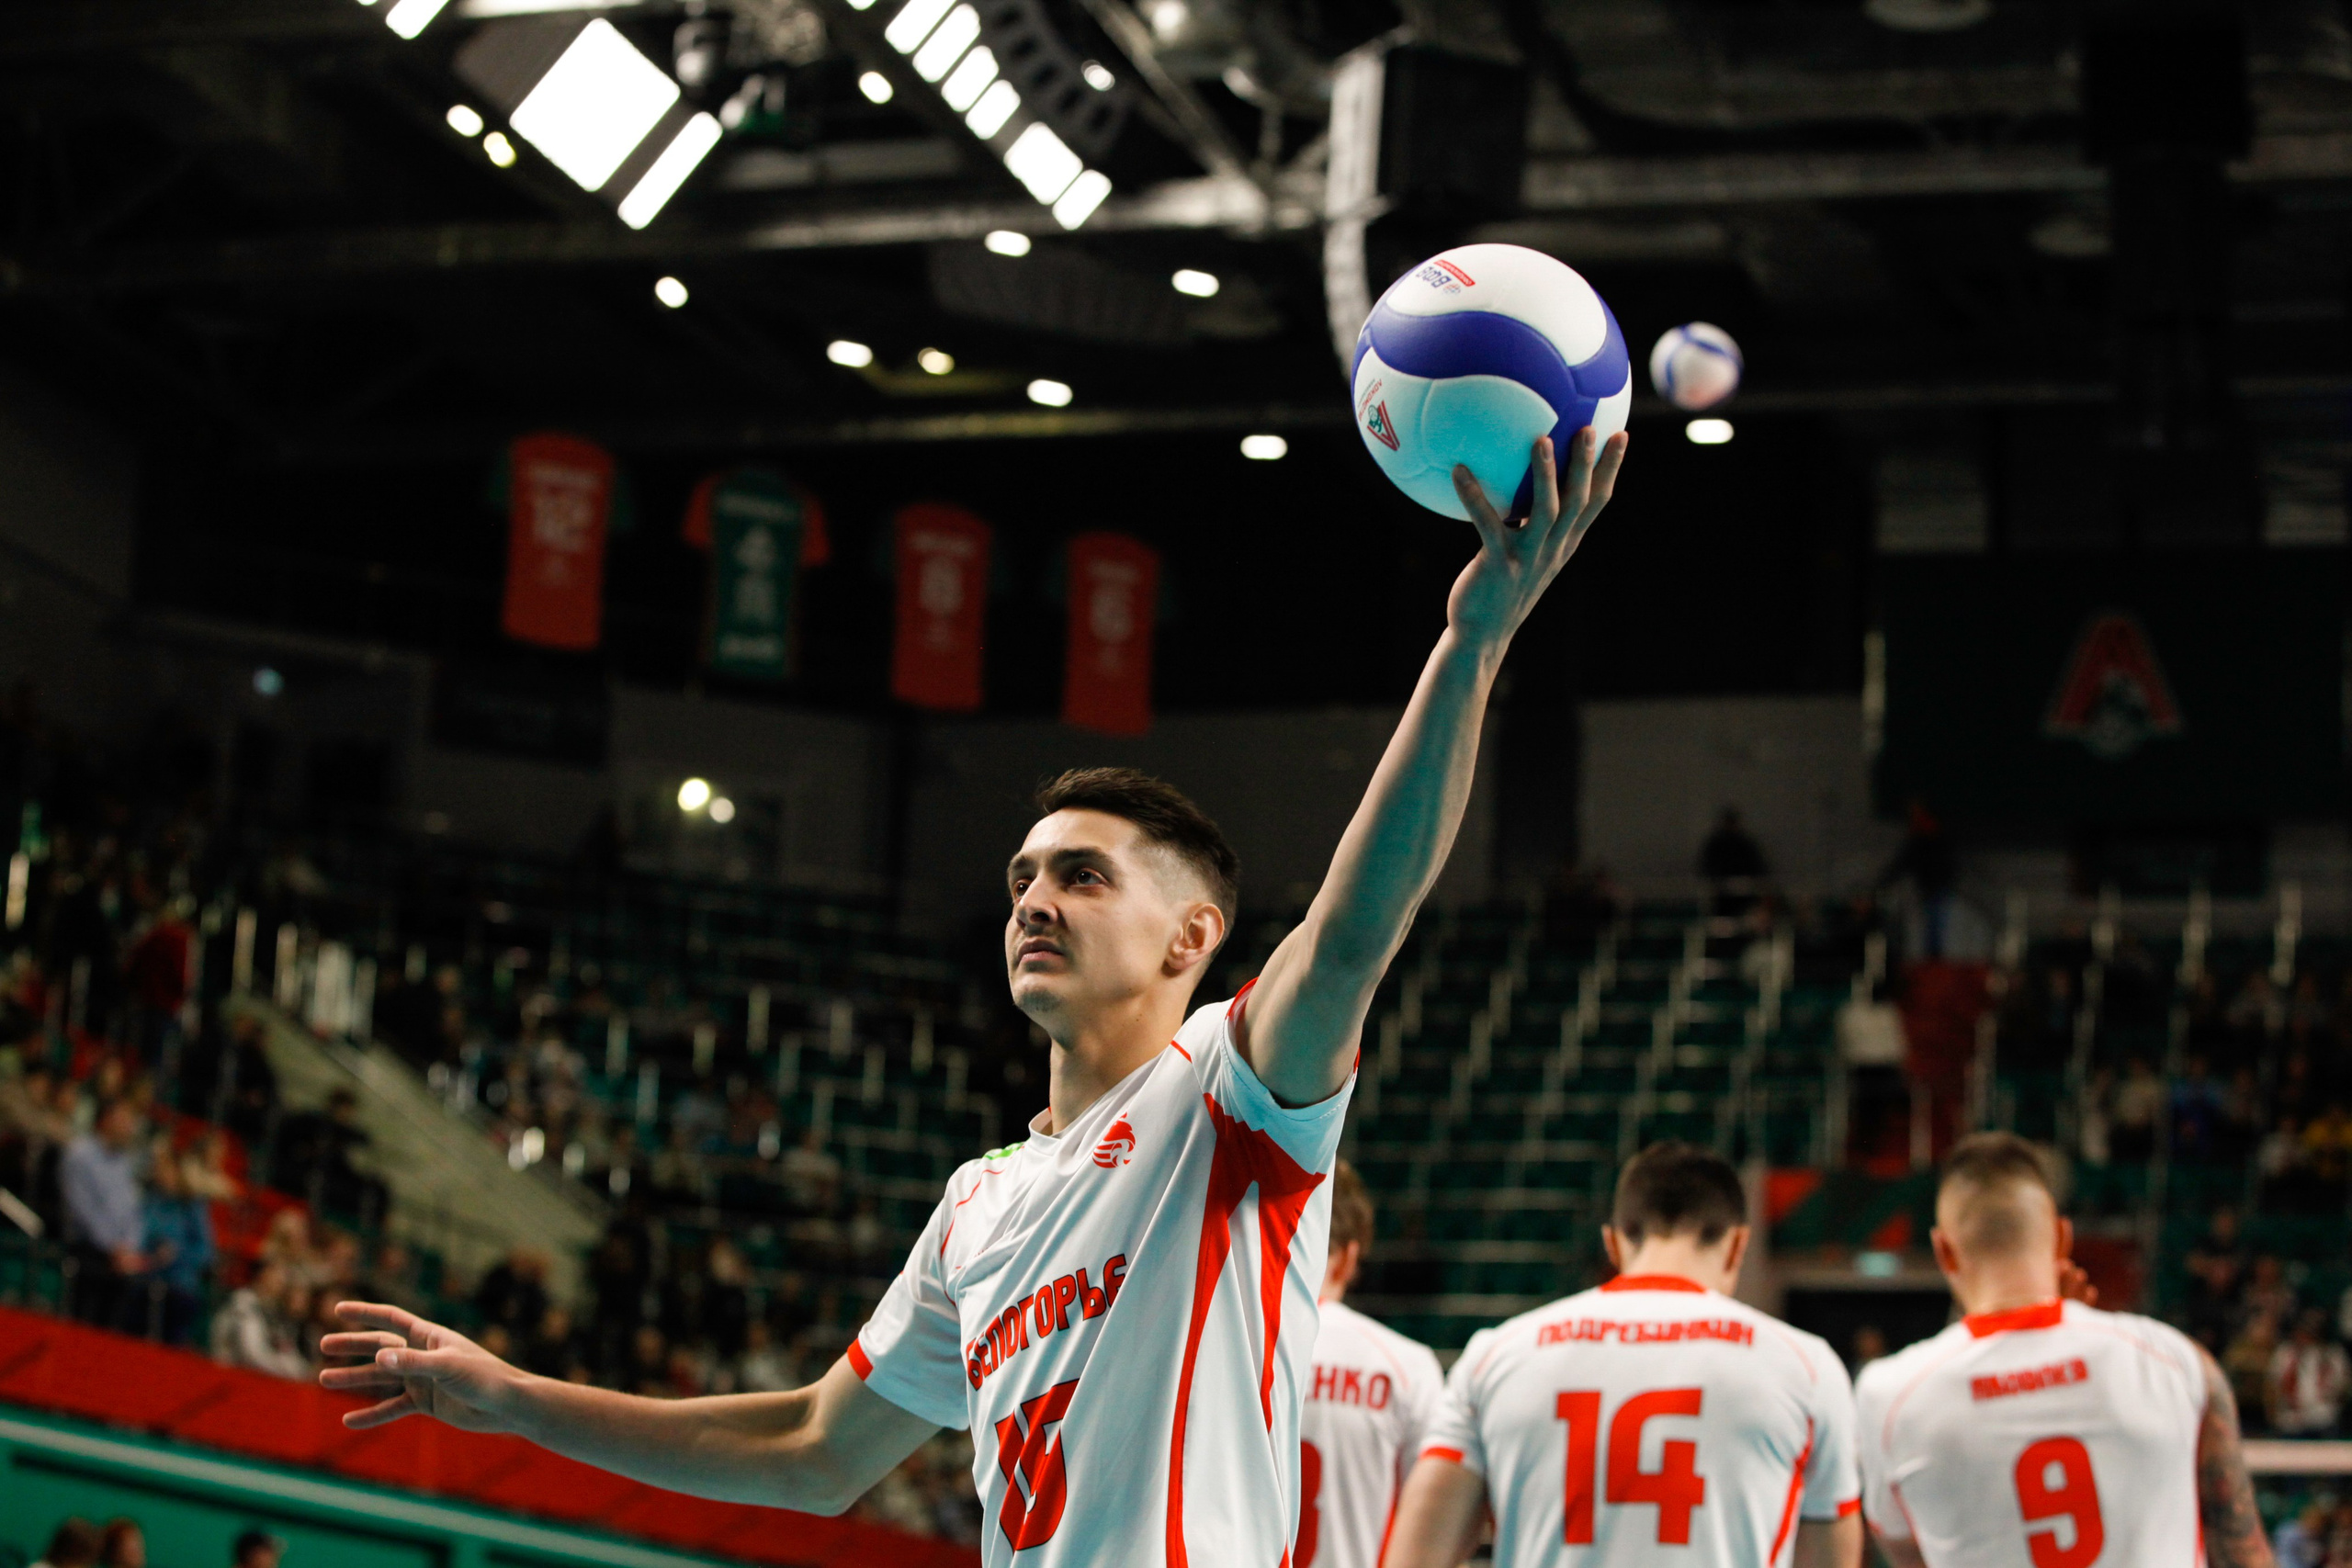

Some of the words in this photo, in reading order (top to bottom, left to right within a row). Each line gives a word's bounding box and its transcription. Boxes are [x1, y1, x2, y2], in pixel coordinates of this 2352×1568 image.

[966, 1253, 1126, 1391] БЕЛОГОРЬЕ
[1306, 1365, 1391, 1410] НКО
[1556, 1388, 1705, 1546] 14
[2014, 1436, 2104, 1568] 9
